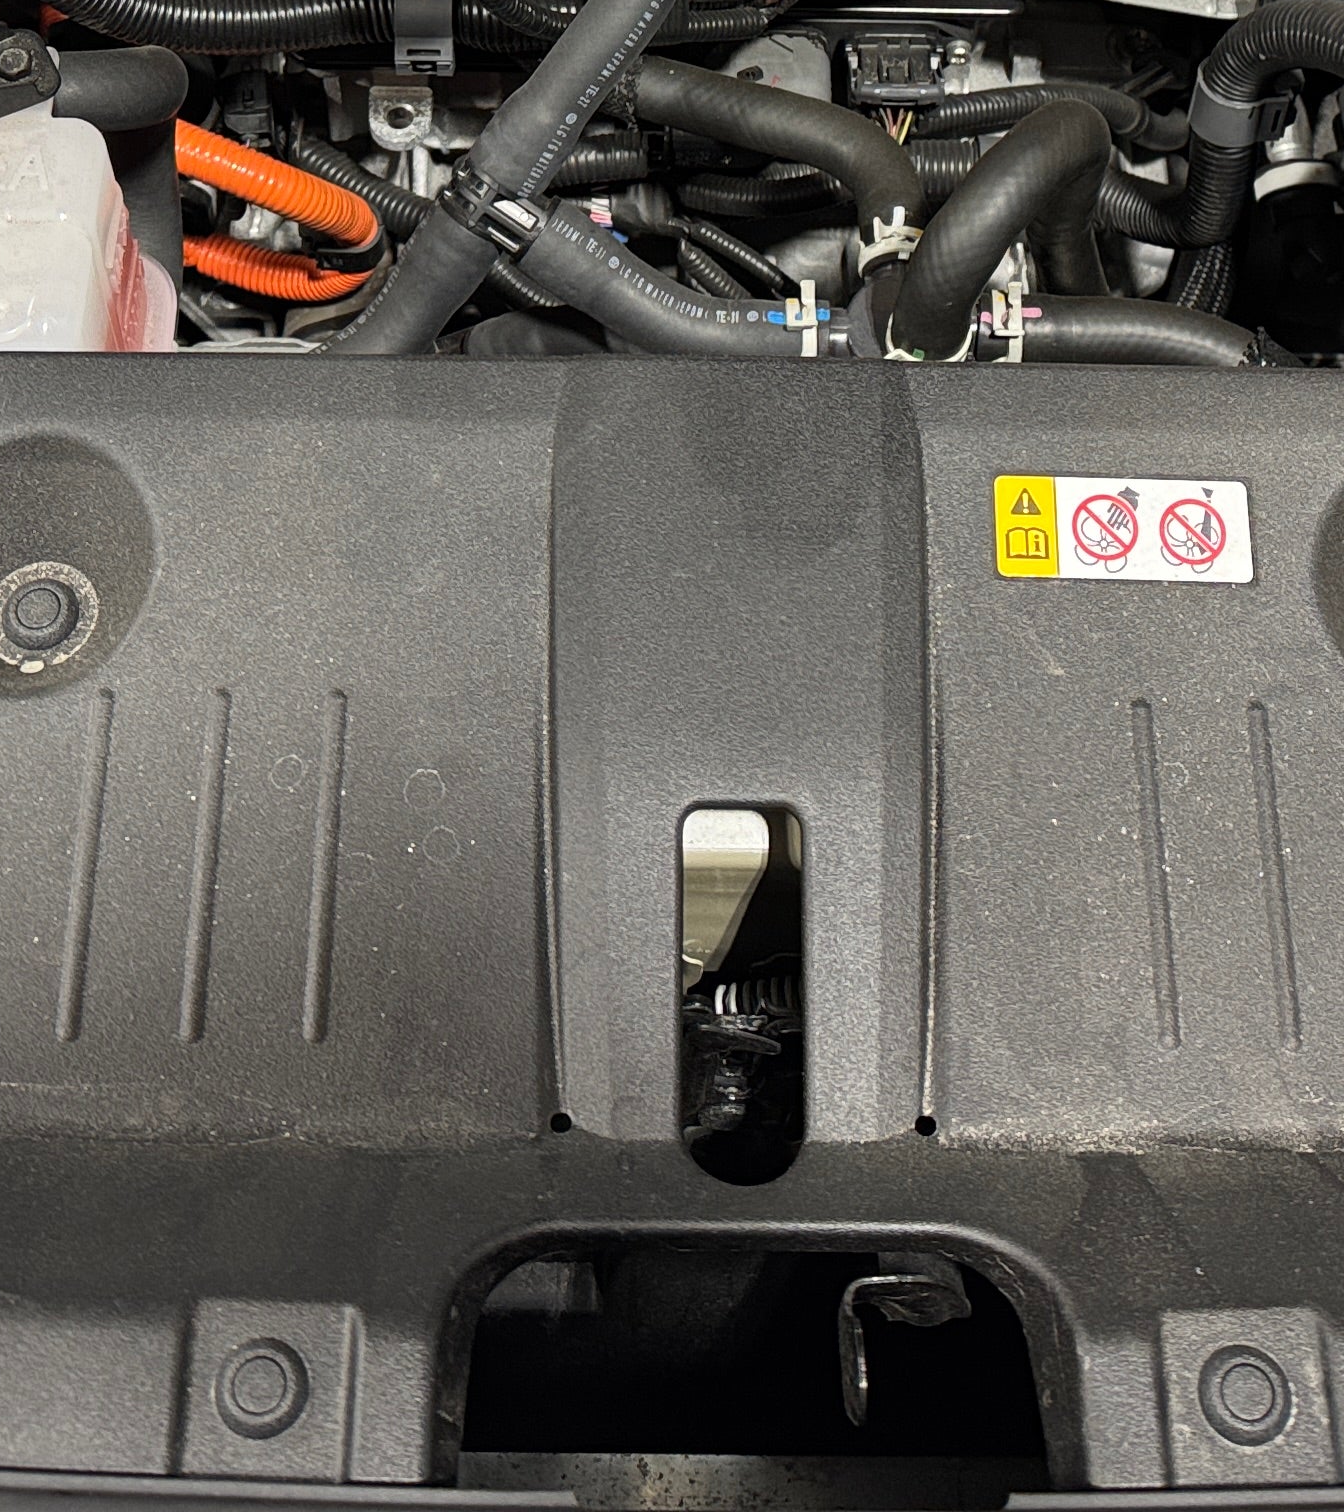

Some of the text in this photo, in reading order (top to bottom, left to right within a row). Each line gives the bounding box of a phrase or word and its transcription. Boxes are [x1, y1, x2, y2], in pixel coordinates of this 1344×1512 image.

[624, 10, 654, 48] WATER
[556, 124, 570, 138] LC
[530, 150, 555, 181] WATER
[619, 263, 632, 279] LC
[644, 282, 675, 308] WATER
